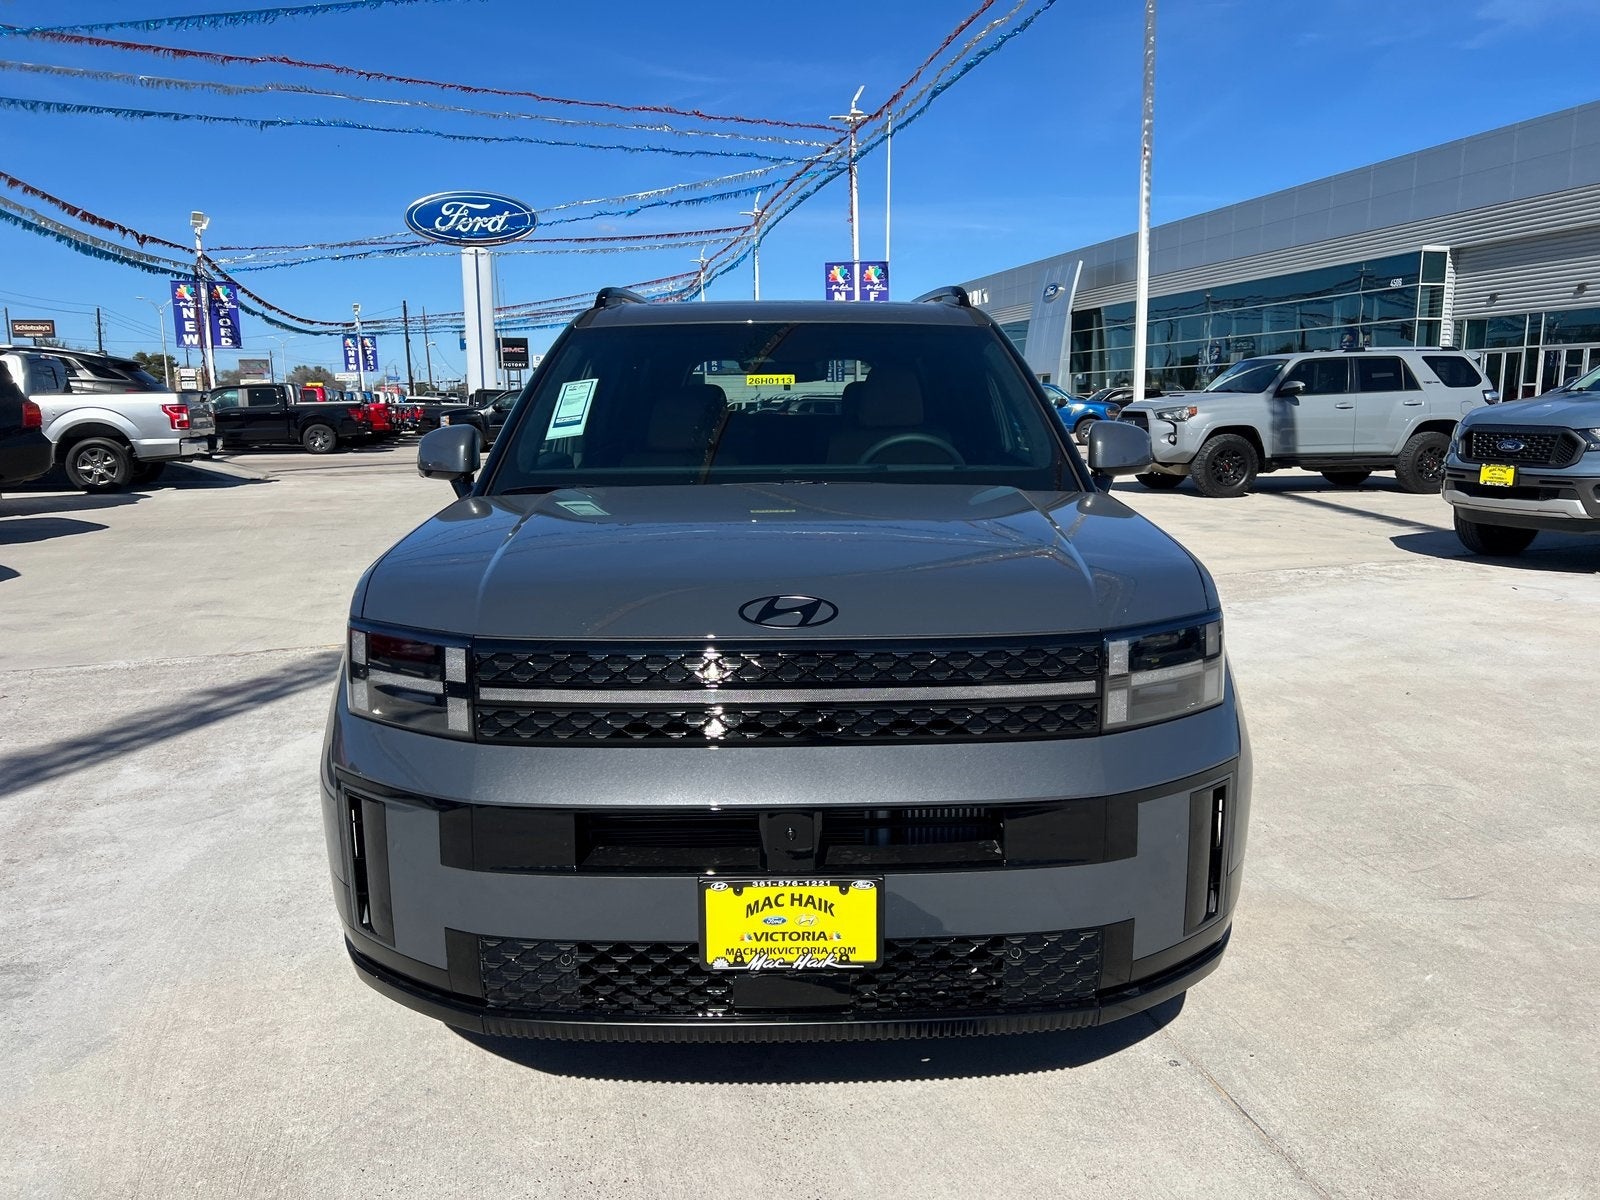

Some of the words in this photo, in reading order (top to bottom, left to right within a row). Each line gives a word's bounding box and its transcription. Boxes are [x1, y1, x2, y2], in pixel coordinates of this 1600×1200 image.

[435, 201, 509, 232] Ford
[182, 307, 199, 345] NEW
[219, 308, 233, 346] FORD
[347, 350, 357, 371] NEW
[366, 350, 374, 371] FORD
[748, 377, 793, 385] 26H0113
[745, 893, 785, 918] MAC
[790, 893, 835, 917] HAIK
[753, 931, 828, 942] VICTORIA
[725, 946, 856, 956] MACHAIKVICTORIA.COM
[747, 953, 792, 970] Mac
[792, 953, 839, 969] Haik
